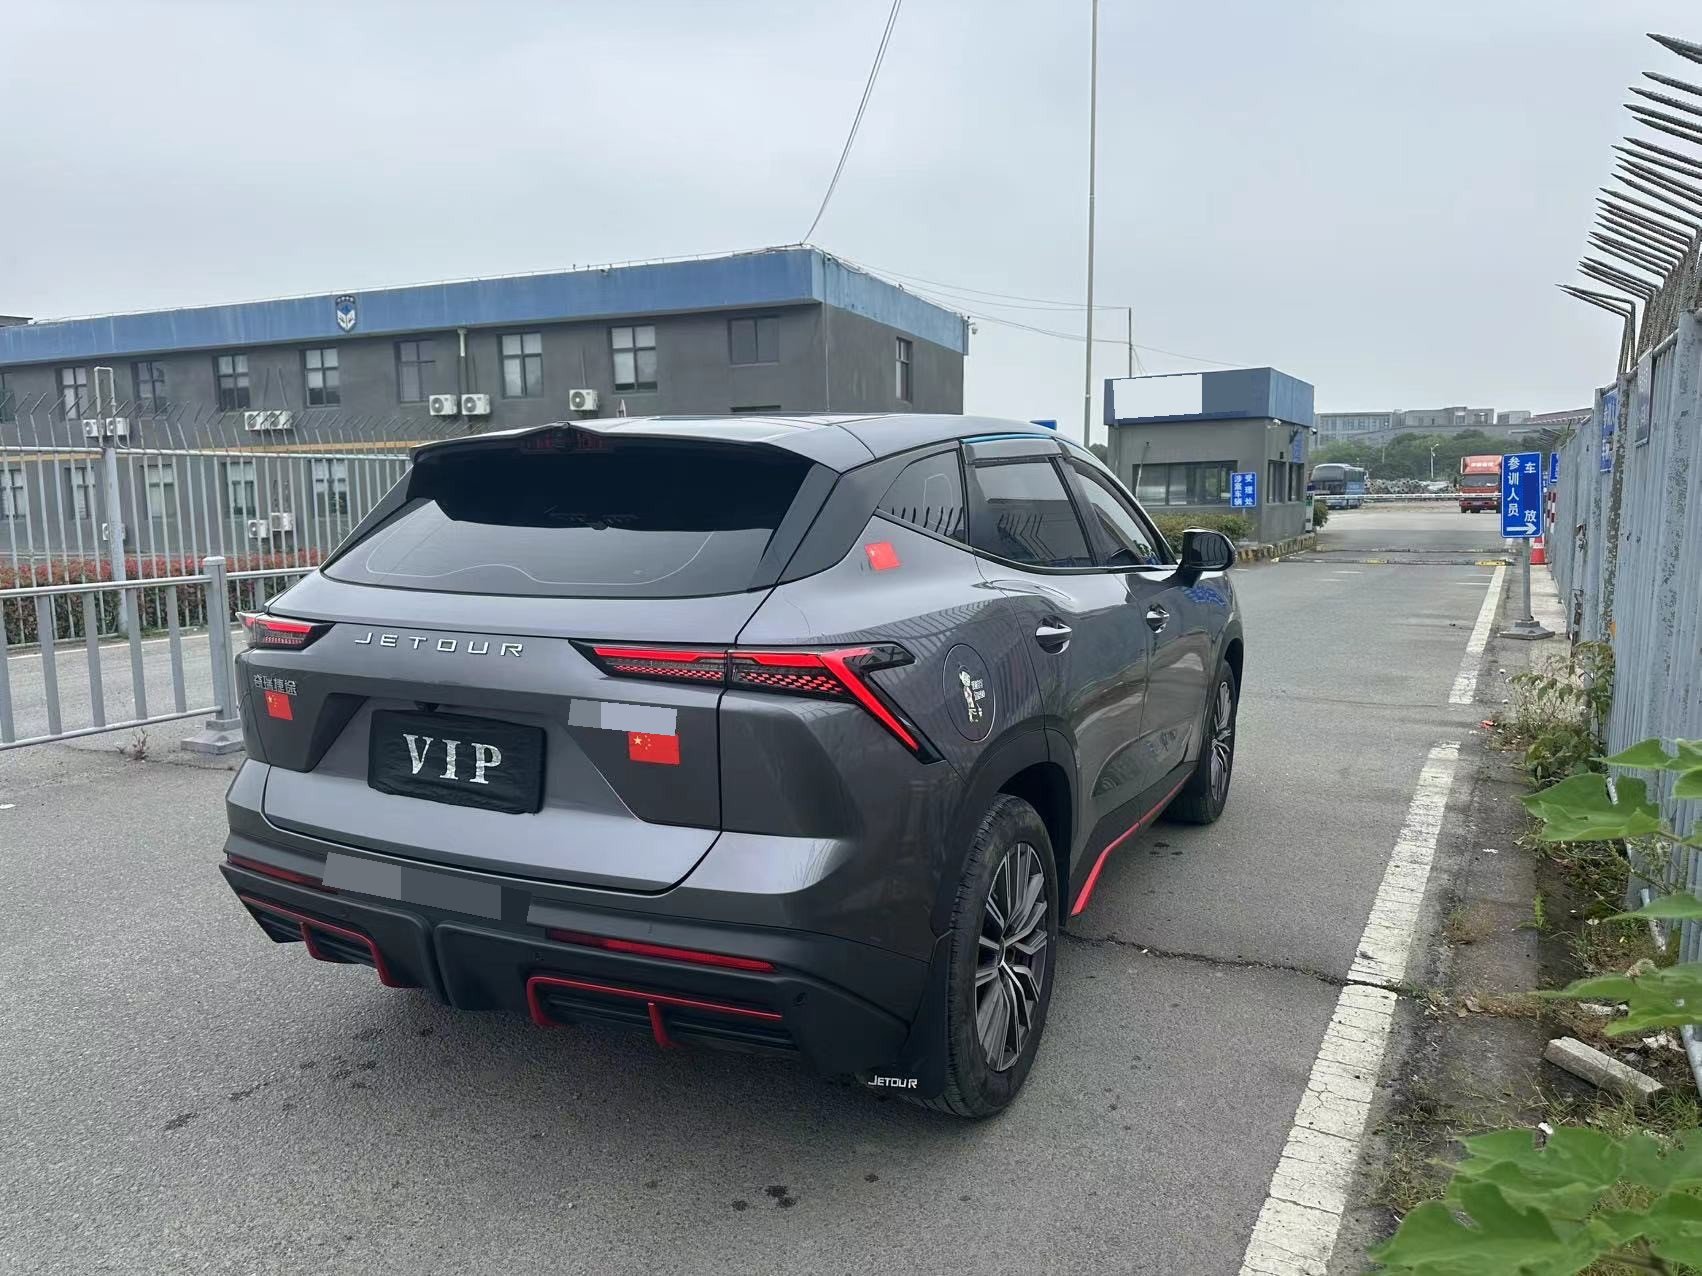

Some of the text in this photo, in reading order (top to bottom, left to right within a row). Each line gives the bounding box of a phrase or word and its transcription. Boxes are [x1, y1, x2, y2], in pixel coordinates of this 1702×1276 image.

[1244, 474, 1253, 505] 受理处
[1507, 456, 1520, 517] 参训人员
[354, 632, 524, 657] JETOUR
[253, 674, 298, 696] 奇瑞捷途
[402, 733, 502, 784] VIP
[868, 1075, 918, 1089] JETOUR
